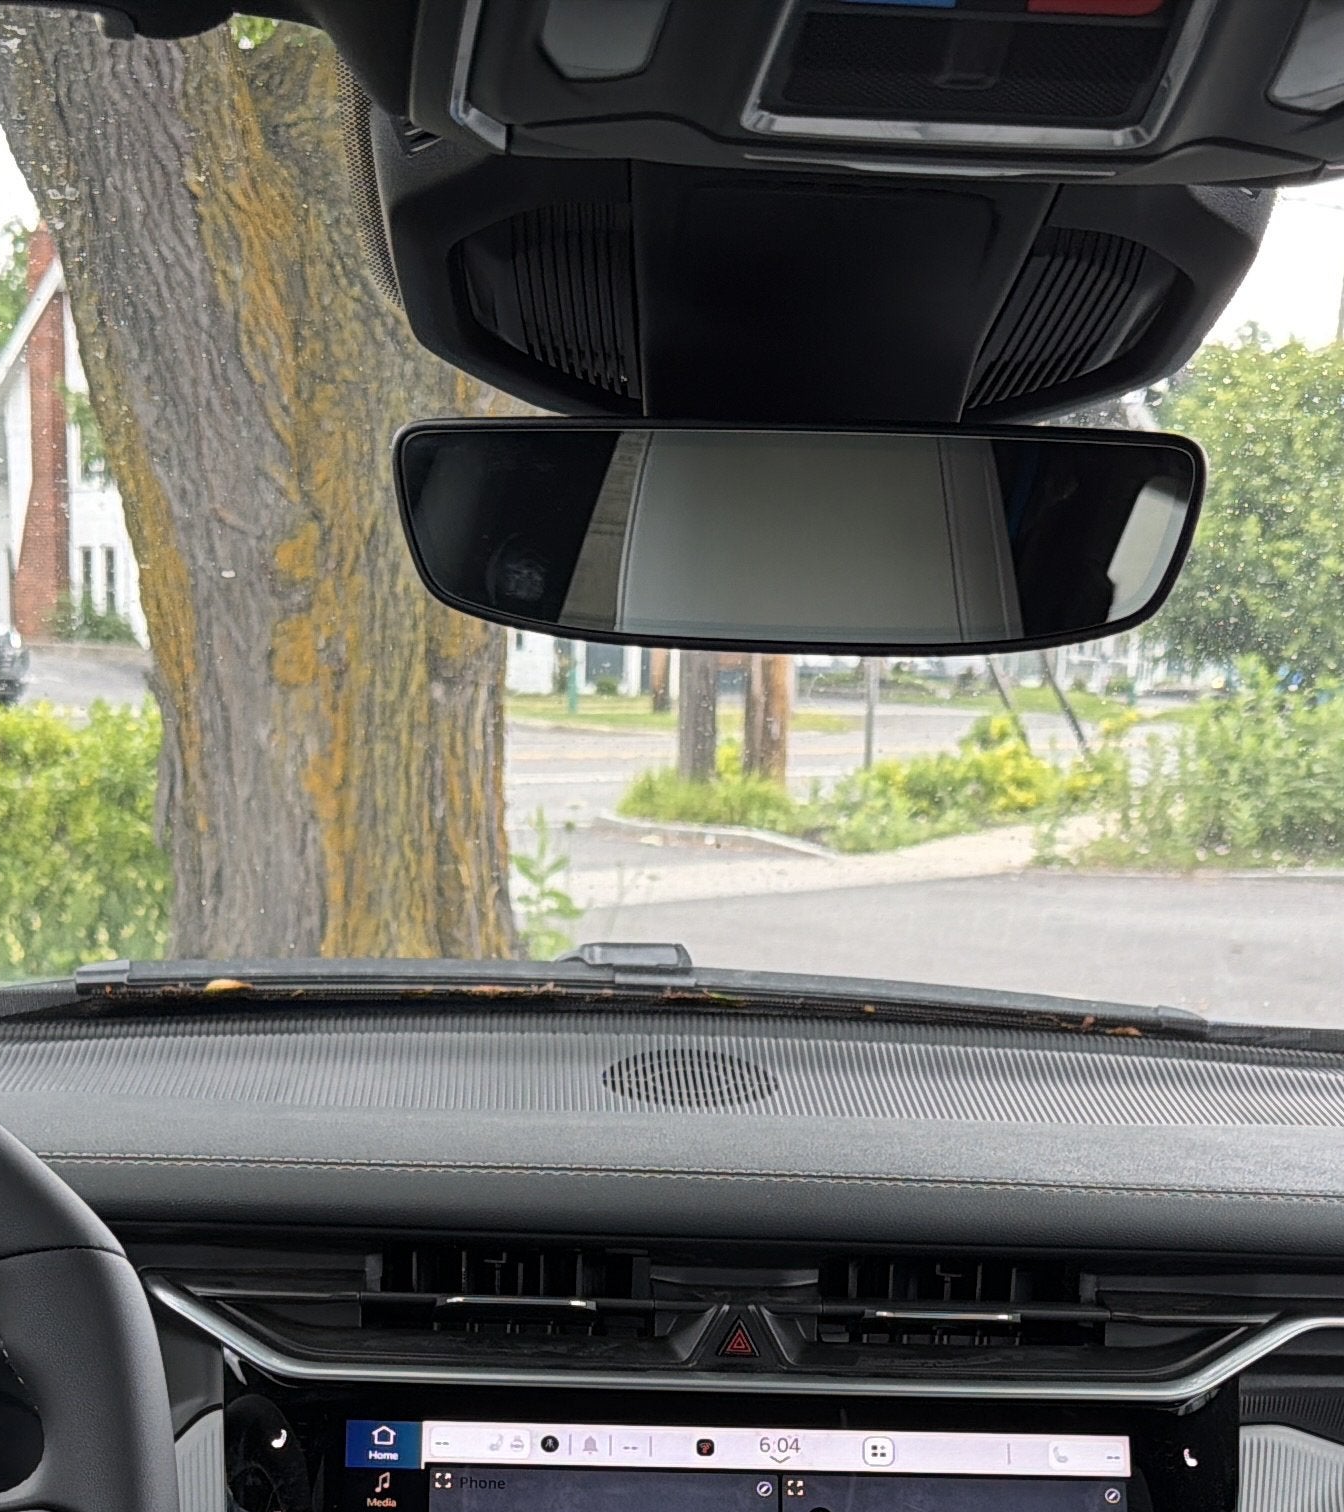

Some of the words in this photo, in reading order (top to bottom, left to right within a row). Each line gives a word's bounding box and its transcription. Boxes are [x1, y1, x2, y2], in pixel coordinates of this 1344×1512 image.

[759, 1436, 801, 1454] 6:04
[368, 1450, 399, 1461] Home
[460, 1476, 506, 1490] Phone
[366, 1498, 397, 1508] Media
